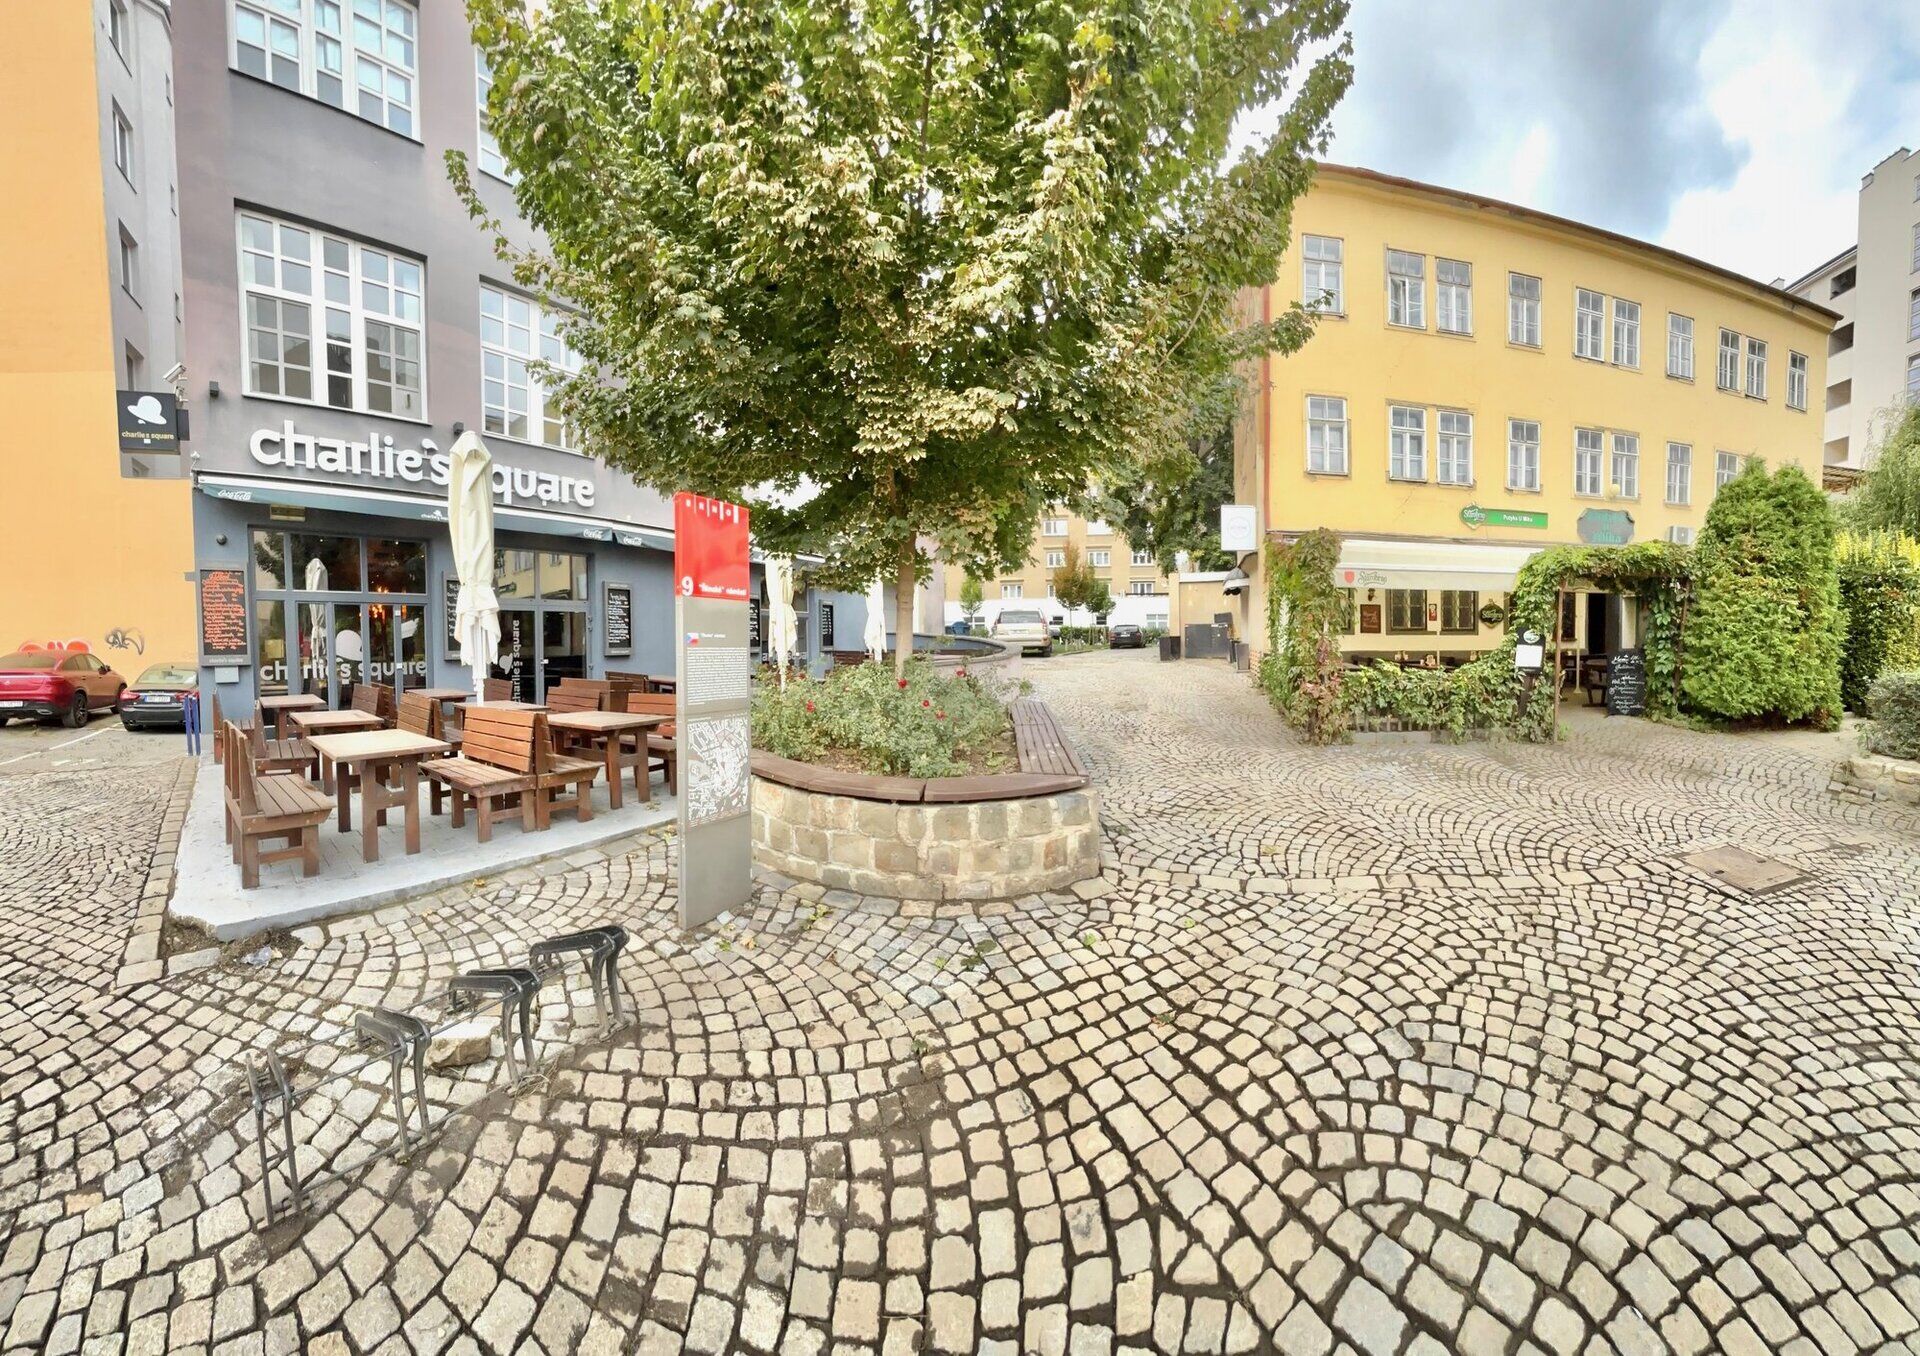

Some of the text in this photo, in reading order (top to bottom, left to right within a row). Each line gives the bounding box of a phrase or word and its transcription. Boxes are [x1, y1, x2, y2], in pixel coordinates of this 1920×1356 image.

[150, 433, 174, 441] square
[249, 419, 595, 508] charlie's quare
[681, 576, 694, 596] 9
[512, 619, 523, 658] square
[260, 657, 351, 681] chrli's
